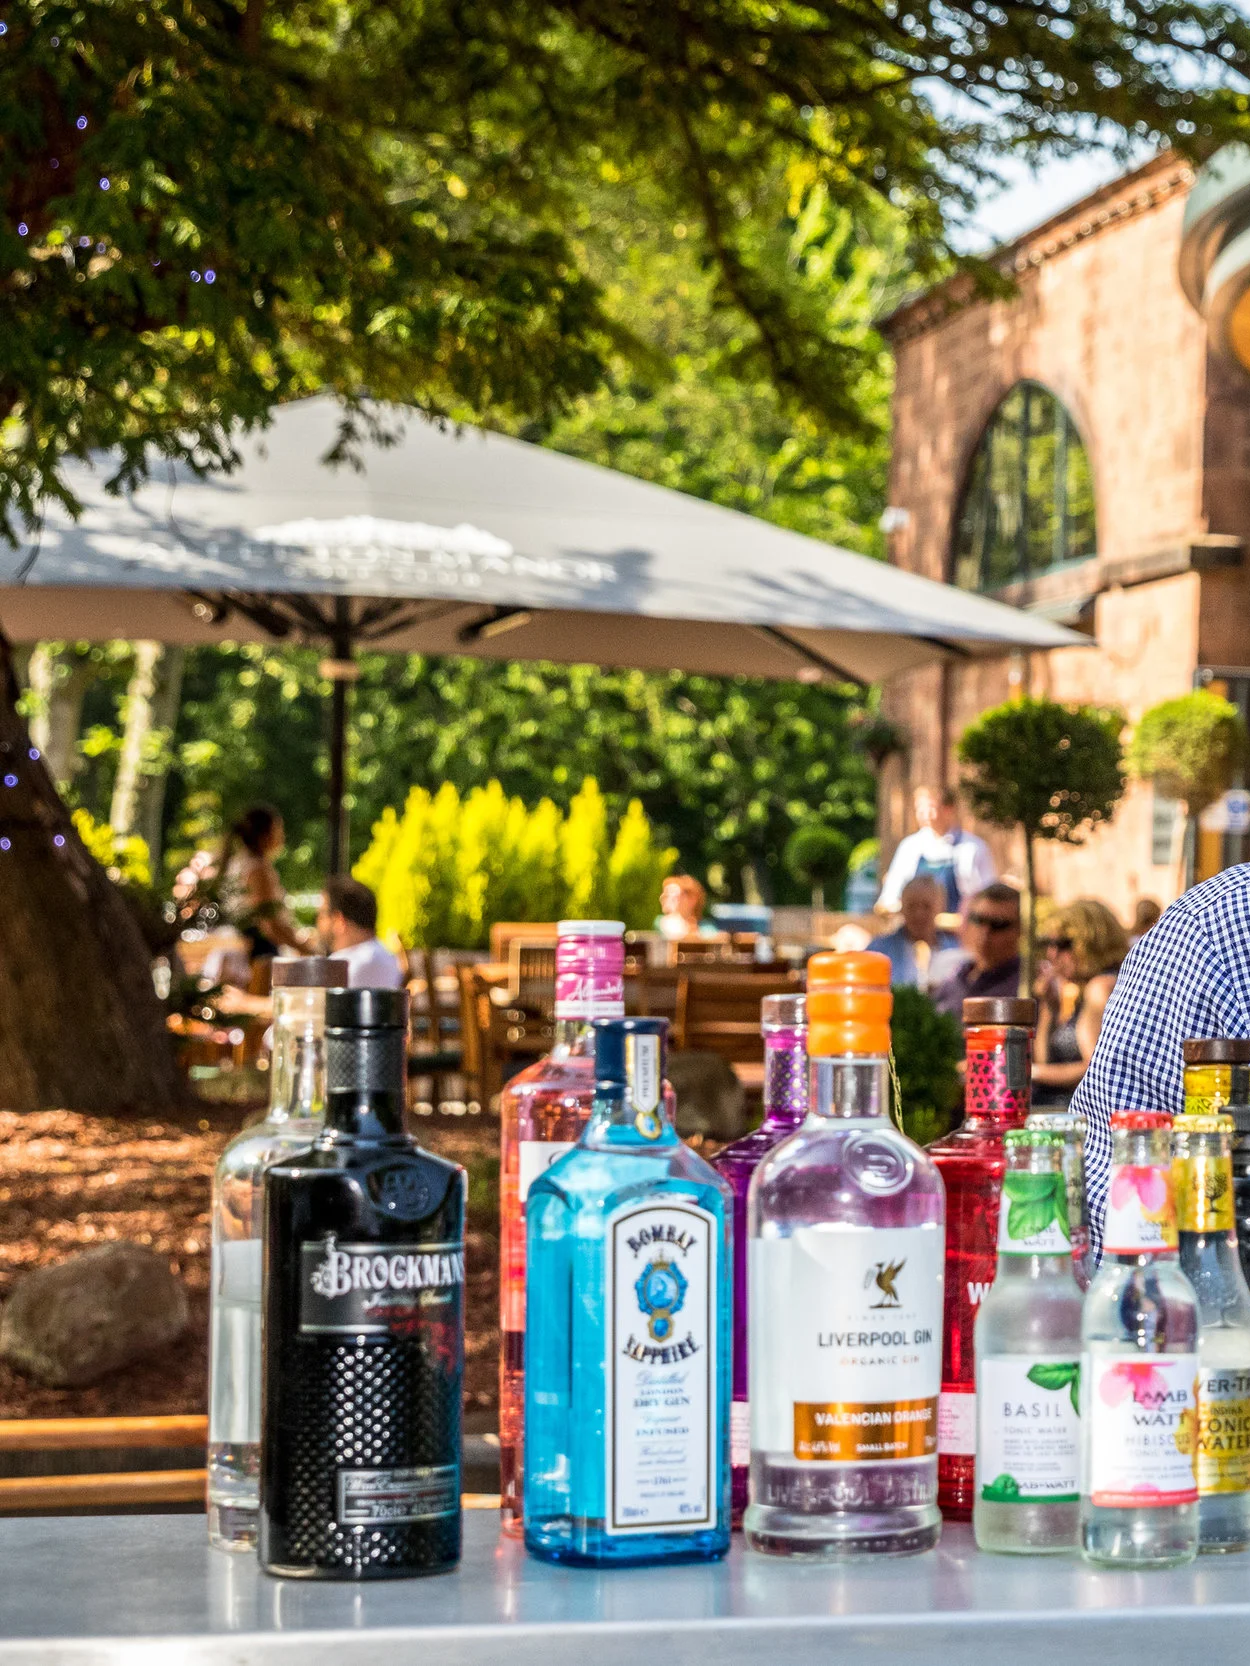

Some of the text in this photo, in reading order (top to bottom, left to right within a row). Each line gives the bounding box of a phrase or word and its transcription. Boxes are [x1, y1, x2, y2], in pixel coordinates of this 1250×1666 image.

[625, 1224, 698, 1256] BOMBAY
[817, 1327, 933, 1348] LIVERPOOL GIN
[622, 1331, 701, 1365] SAPPHIRE
[1132, 1389, 1188, 1403] LAMB
[815, 1407, 933, 1427] VALENCIAN ORANGE
[1003, 1402, 1063, 1418] BASIL
[1133, 1413, 1186, 1427] WATT
